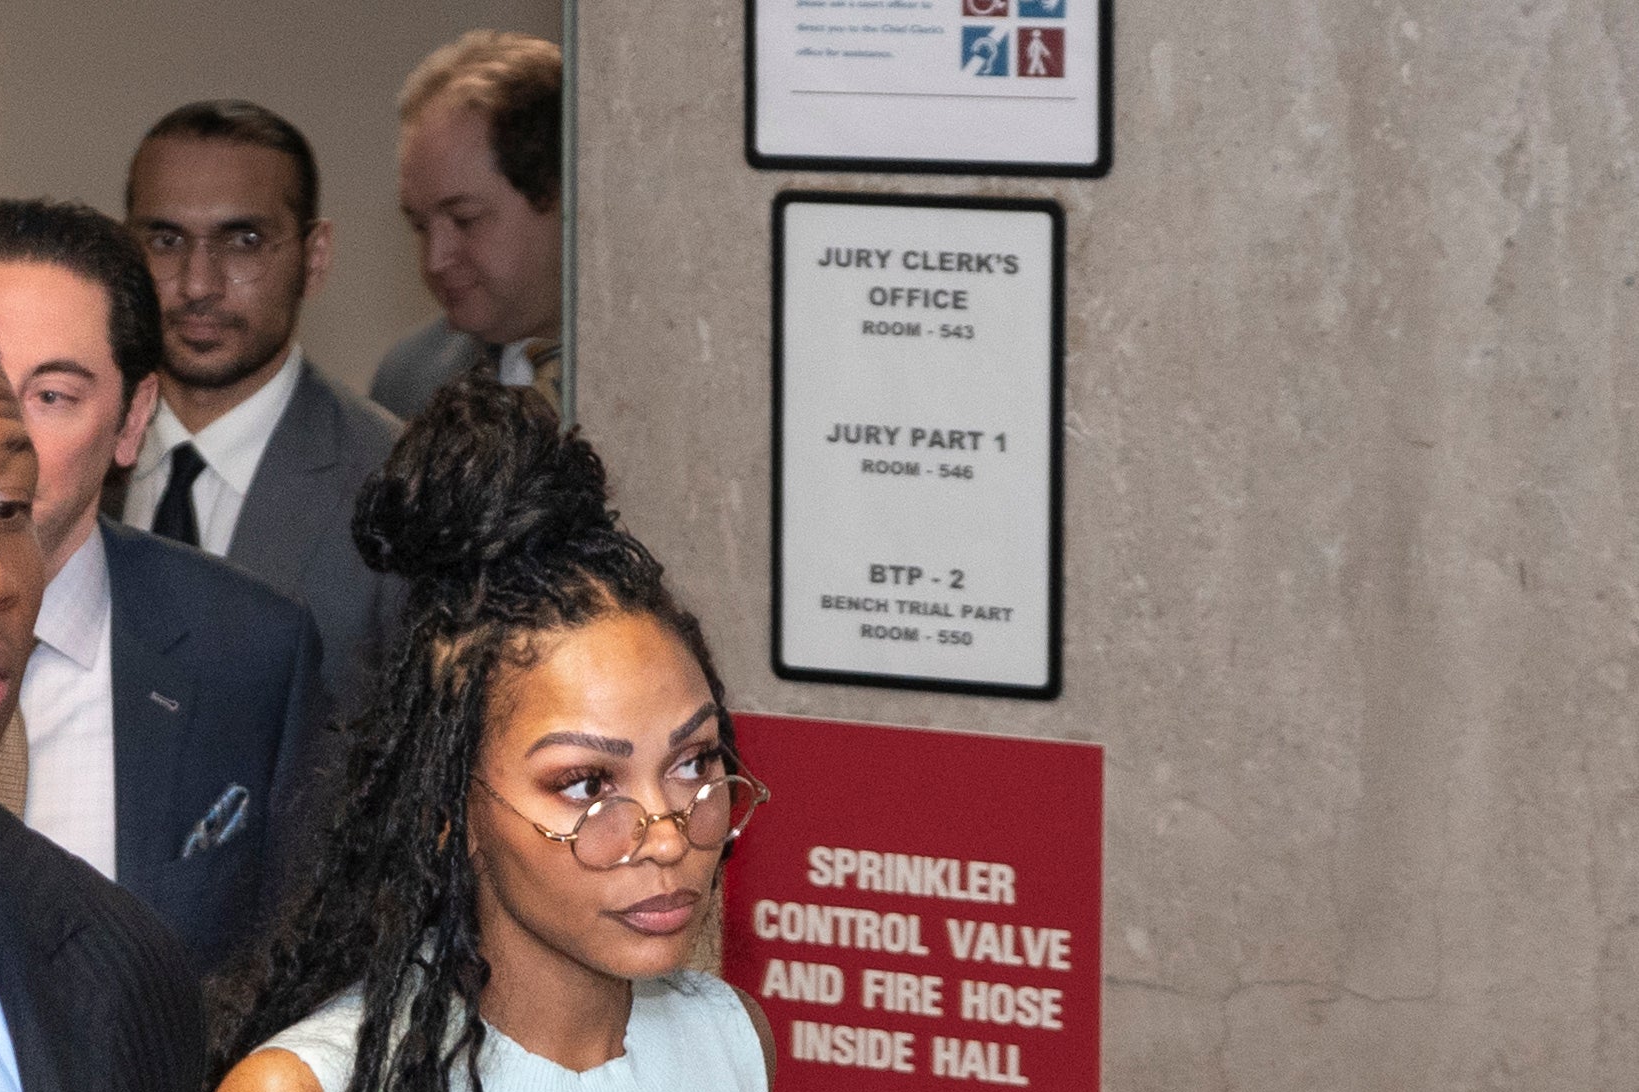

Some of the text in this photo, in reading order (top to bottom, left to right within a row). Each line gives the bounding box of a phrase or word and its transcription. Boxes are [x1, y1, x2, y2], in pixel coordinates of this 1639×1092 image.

[817, 247, 1020, 276] JURY CLERK'S
[868, 285, 968, 311] OFFICE
[861, 319, 922, 338] ROOM
[939, 323, 975, 341] 543
[825, 423, 1007, 453] JURY PART 1
[860, 458, 921, 477] ROOM
[939, 463, 974, 481] 546
[869, 563, 924, 586] BTP
[949, 568, 965, 591] 2
[820, 594, 1015, 622] BENCH TRIAL PART
[860, 623, 920, 643] ROOM
[937, 628, 974, 647] 550
[807, 845, 1016, 905] SPRINKLER
[754, 899, 1072, 971] CONTROL VALVE
[761, 958, 1063, 1030] AND FIRE HOSE
[792, 1020, 1029, 1087] INSIDE HALL
